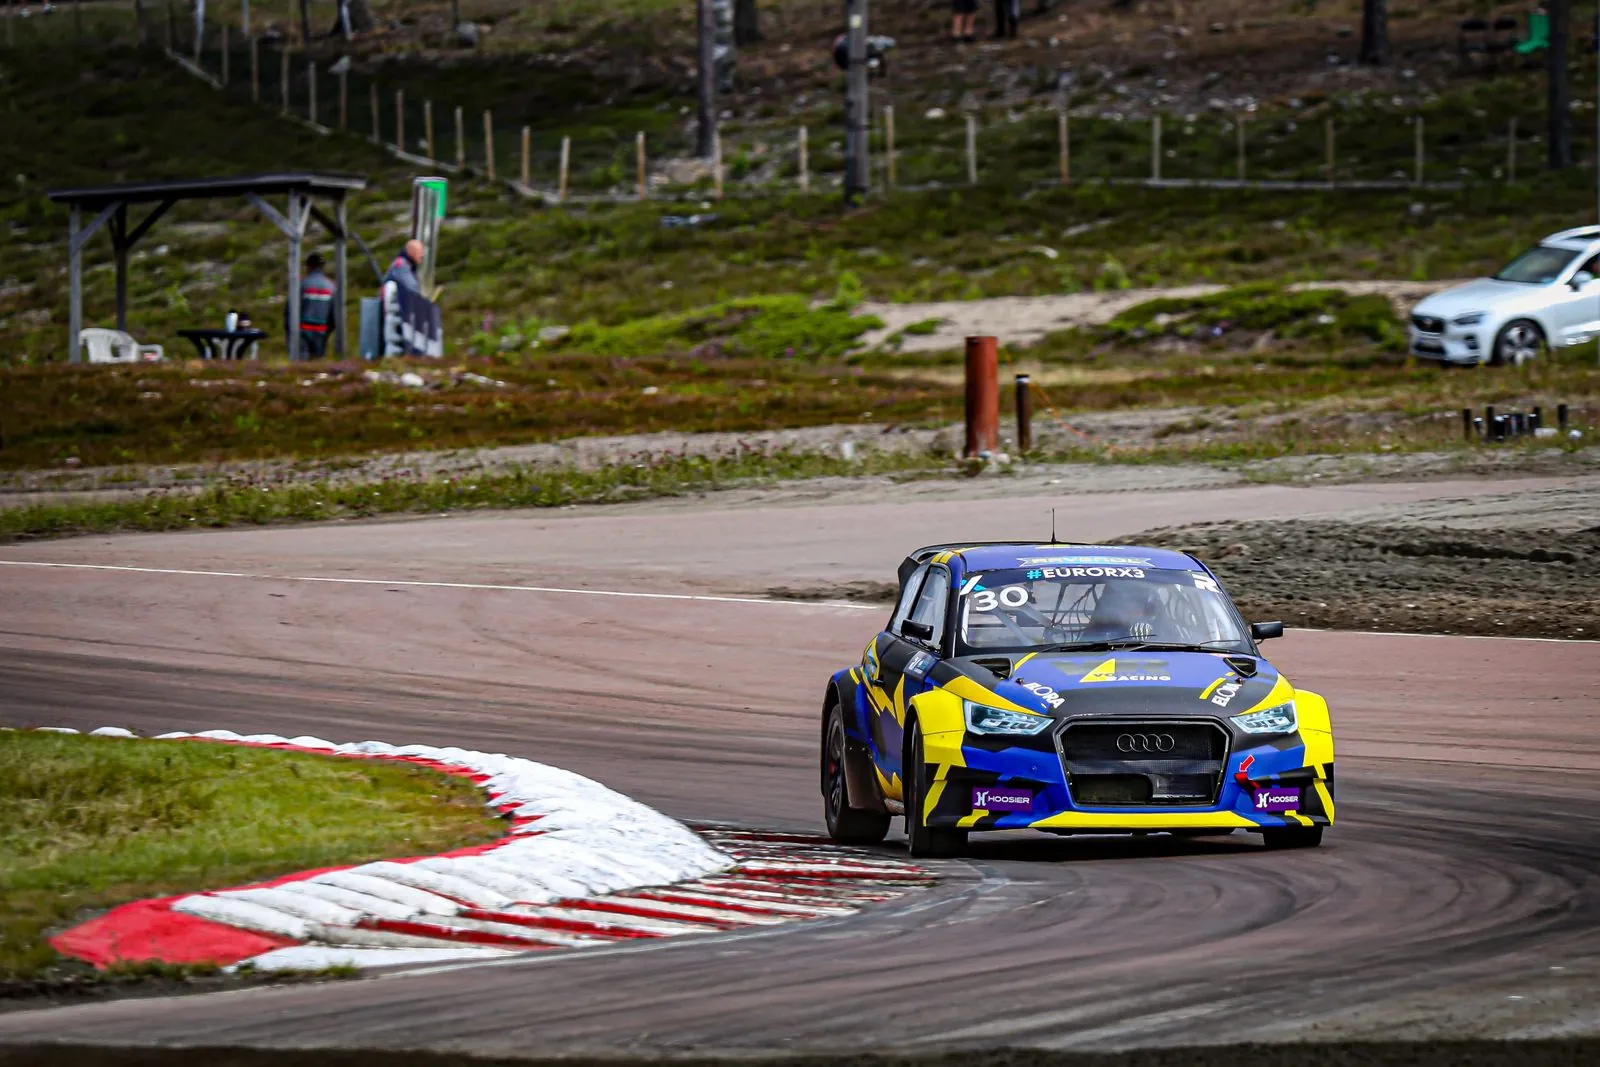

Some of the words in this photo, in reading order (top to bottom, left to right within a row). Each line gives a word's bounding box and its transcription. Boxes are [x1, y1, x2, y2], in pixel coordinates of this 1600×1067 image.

[1026, 567, 1145, 579] #EURORX3
[974, 586, 1029, 612] 30
[988, 795, 1030, 804] HOOSIER
[1268, 795, 1299, 803] HOOSIER
